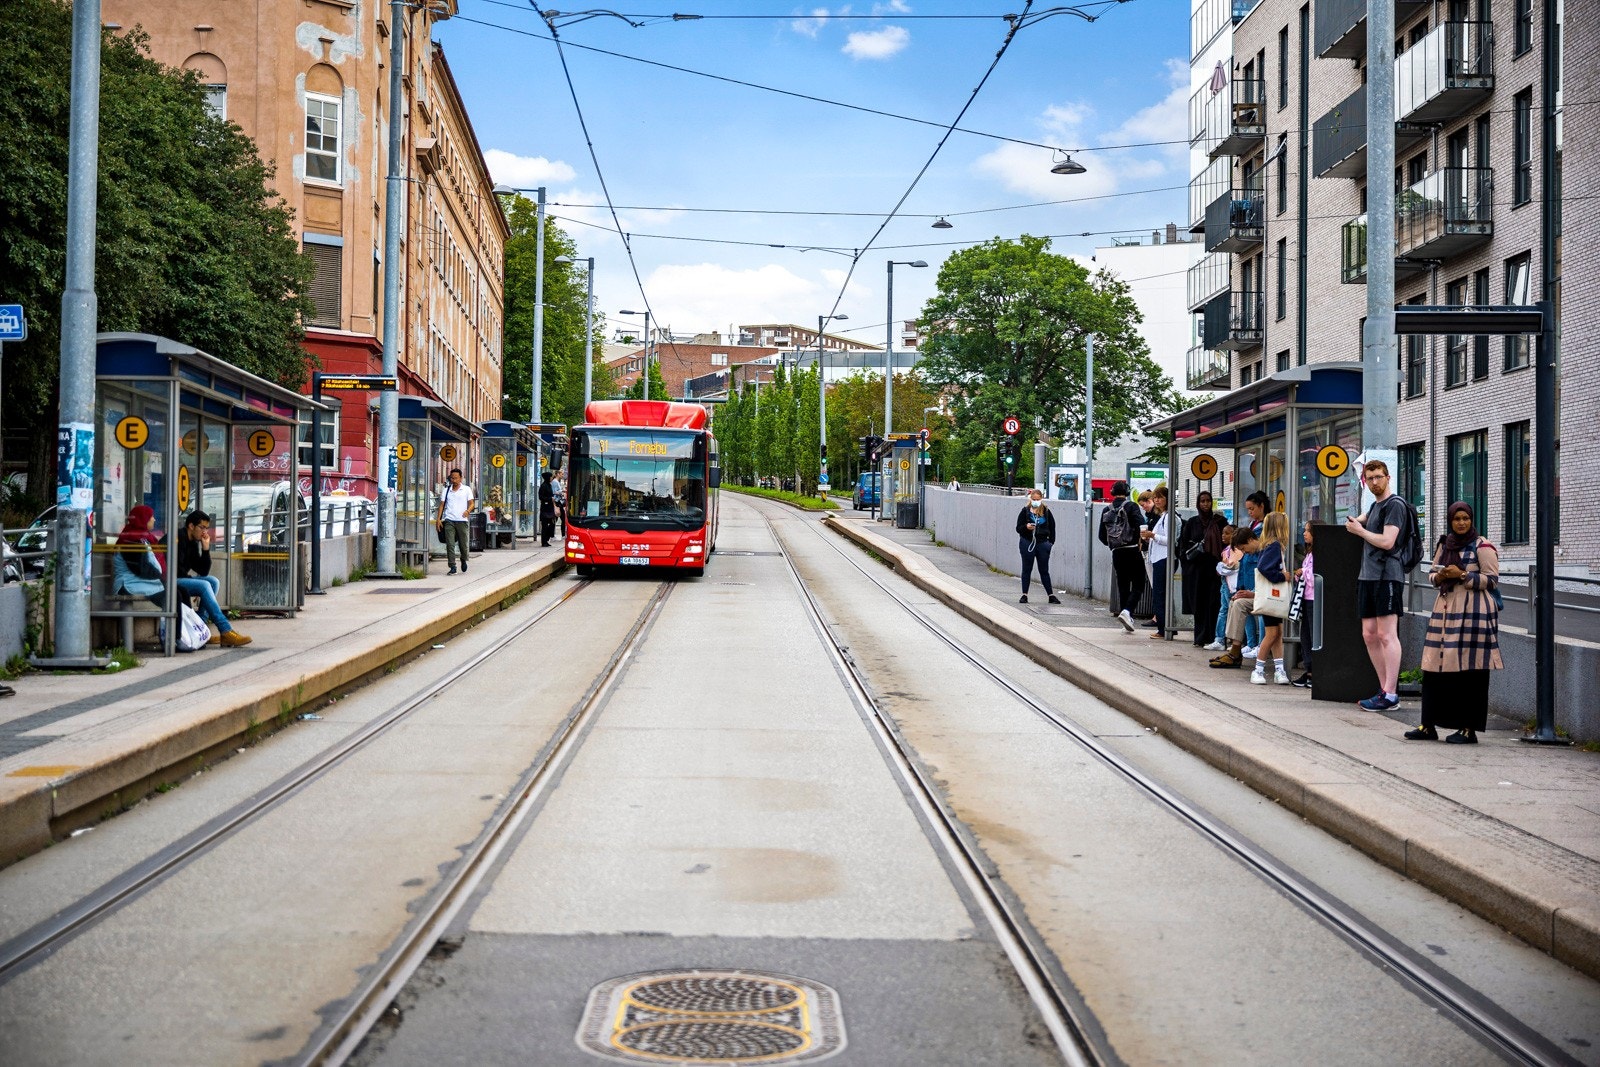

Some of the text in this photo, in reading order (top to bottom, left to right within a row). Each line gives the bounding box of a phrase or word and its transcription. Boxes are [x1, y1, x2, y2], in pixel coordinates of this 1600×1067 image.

[126, 423, 139, 442] E
[256, 436, 266, 451] E
[629, 440, 667, 455] Fornebu
[401, 446, 408, 457] E
[445, 448, 452, 458] E
[495, 457, 502, 465] F
[1199, 459, 1210, 475] C
[1326, 452, 1340, 471] C
[181, 475, 186, 502] E
[621, 543, 650, 551] MAN
